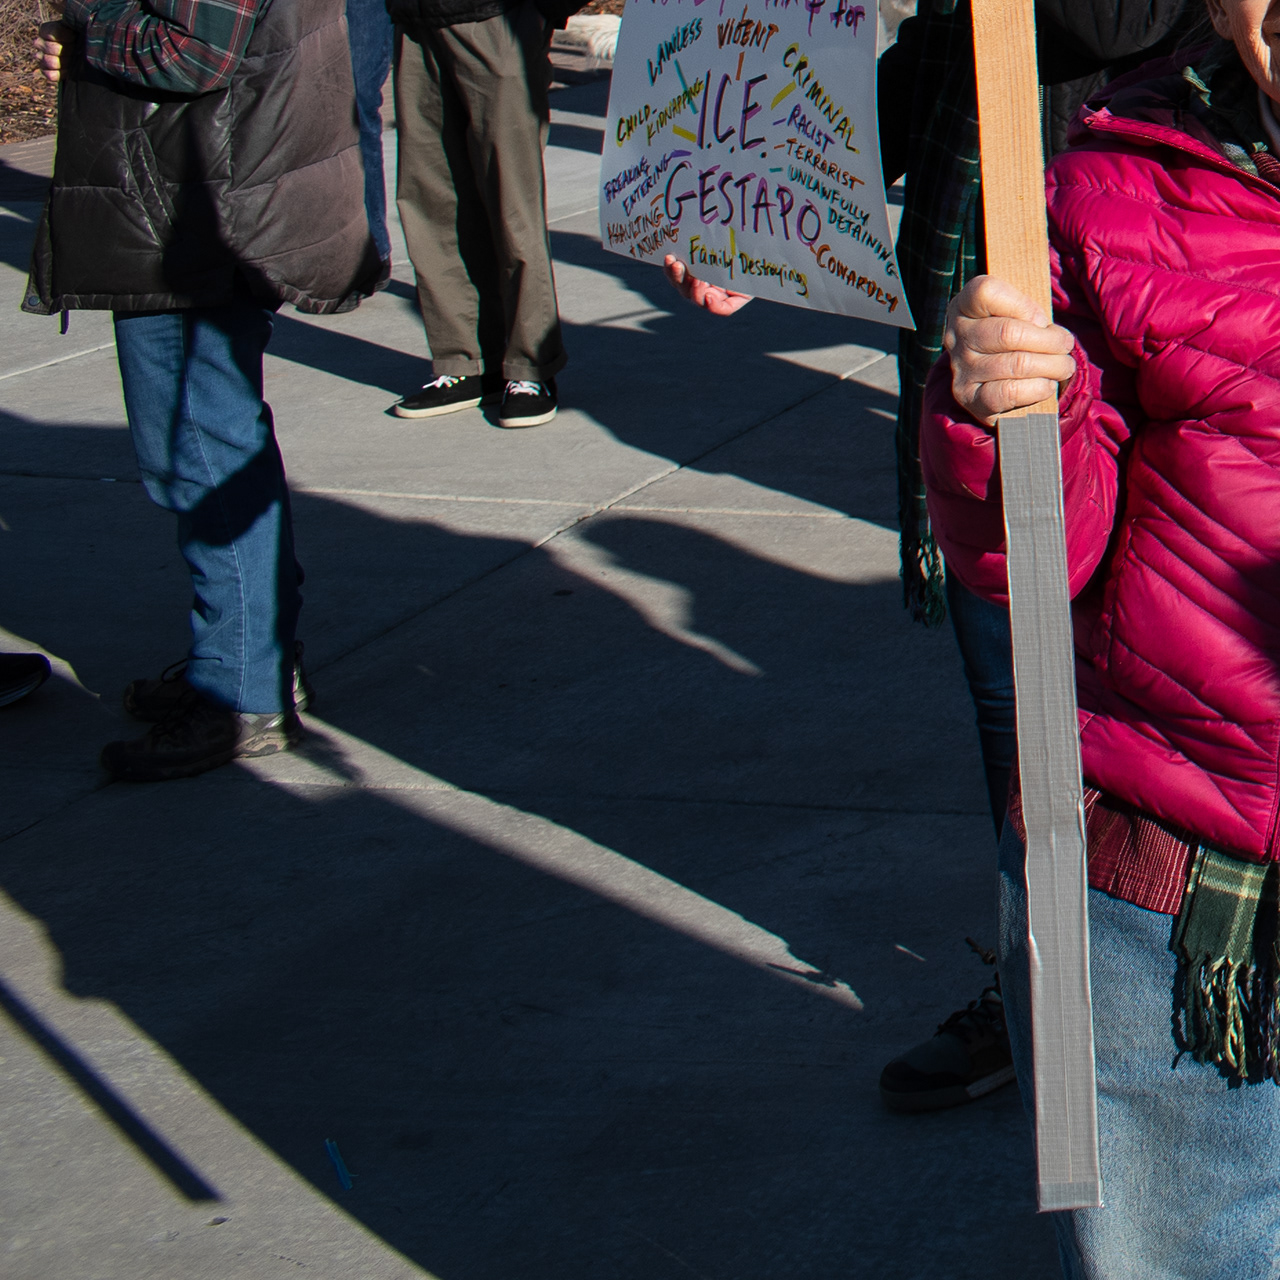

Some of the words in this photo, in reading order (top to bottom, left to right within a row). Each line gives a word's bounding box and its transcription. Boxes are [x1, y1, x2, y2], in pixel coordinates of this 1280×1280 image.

[647, 18, 703, 86] LAWLESS
[646, 77, 704, 146] KIDNAPPING
[782, 42, 860, 154] CRIMINAL
[787, 103, 835, 153] RACIST
[622, 153, 672, 217] ENTERING
[786, 137, 865, 191] TERRORIST
[787, 165, 870, 224] UNLAWFULLY
[664, 160, 822, 247] GESTAPO
[689, 235, 735, 280] Family
[738, 251, 809, 298] Destroying
[827, 206, 899, 280] DETAINING
[815, 244, 899, 313] COWARDLY
